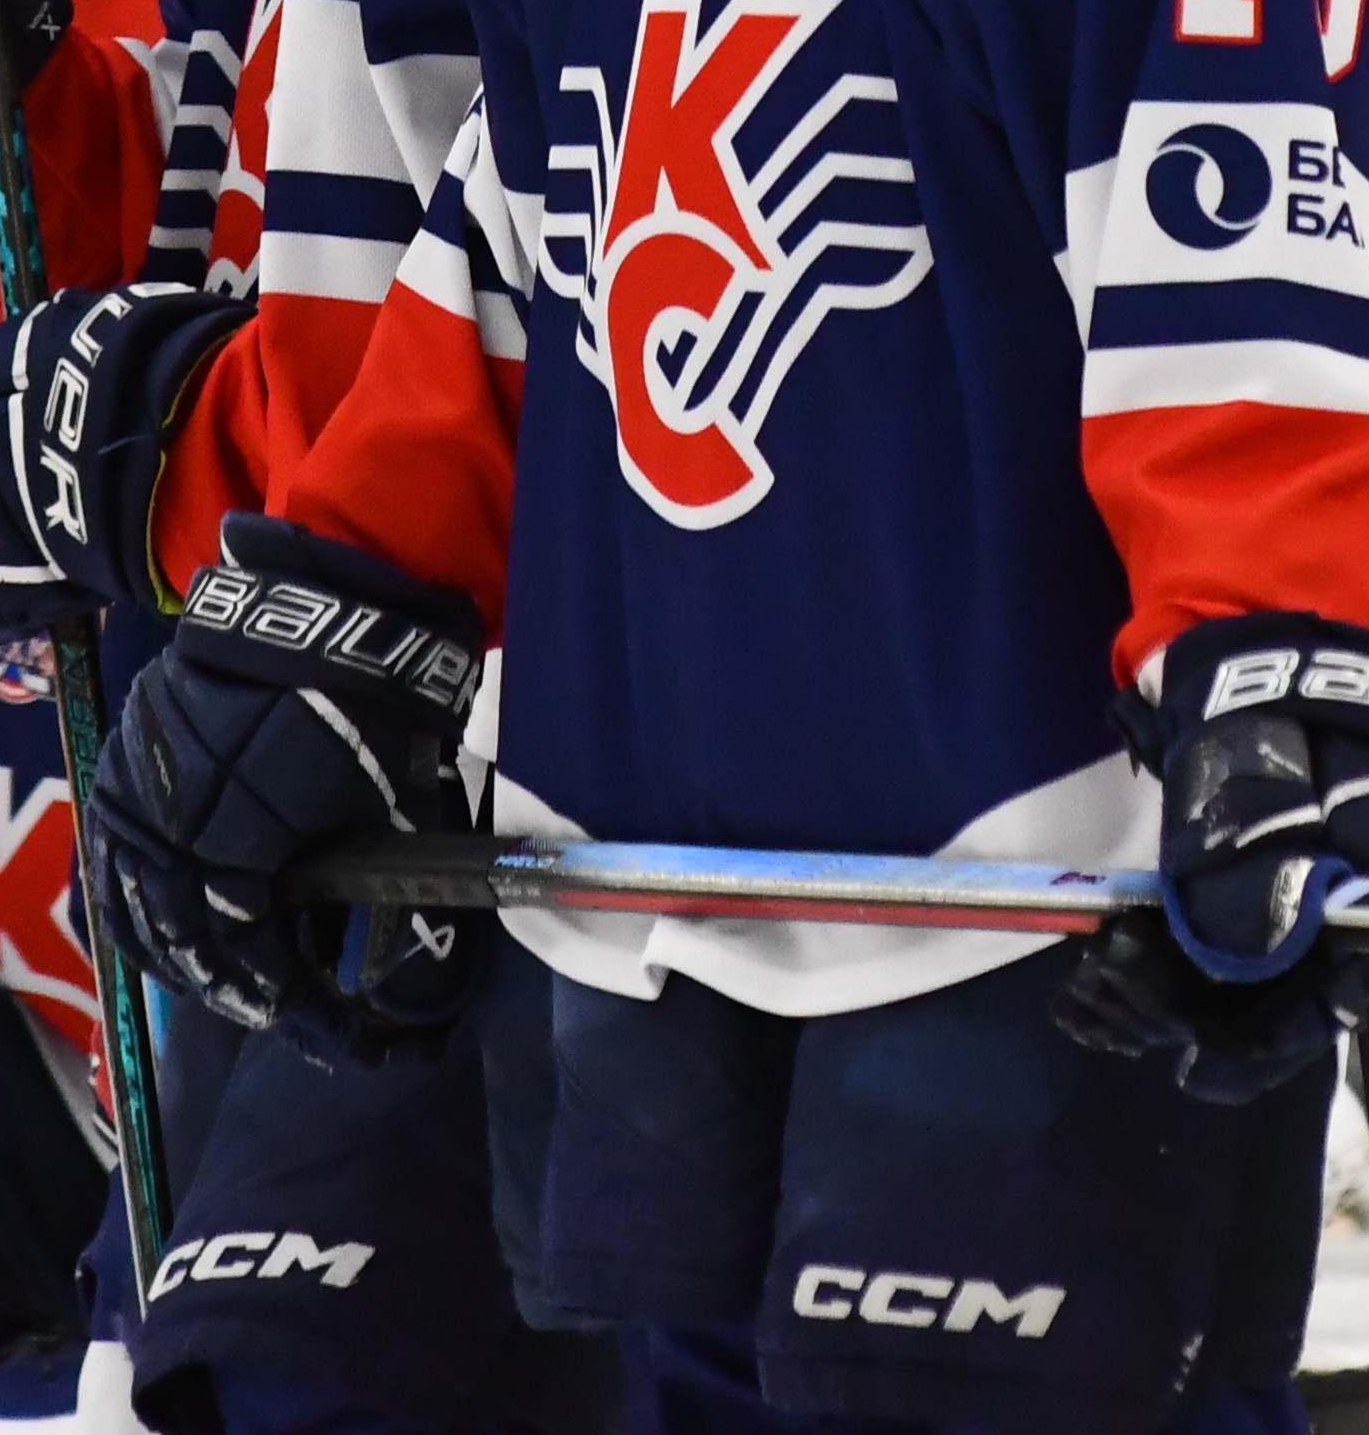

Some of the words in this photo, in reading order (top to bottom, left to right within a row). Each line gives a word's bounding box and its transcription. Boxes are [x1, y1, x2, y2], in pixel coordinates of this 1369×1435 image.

[1286, 193, 1366, 250] БА
[147, 1230, 377, 1303] CCM
[792, 1260, 1068, 1339] CCM
